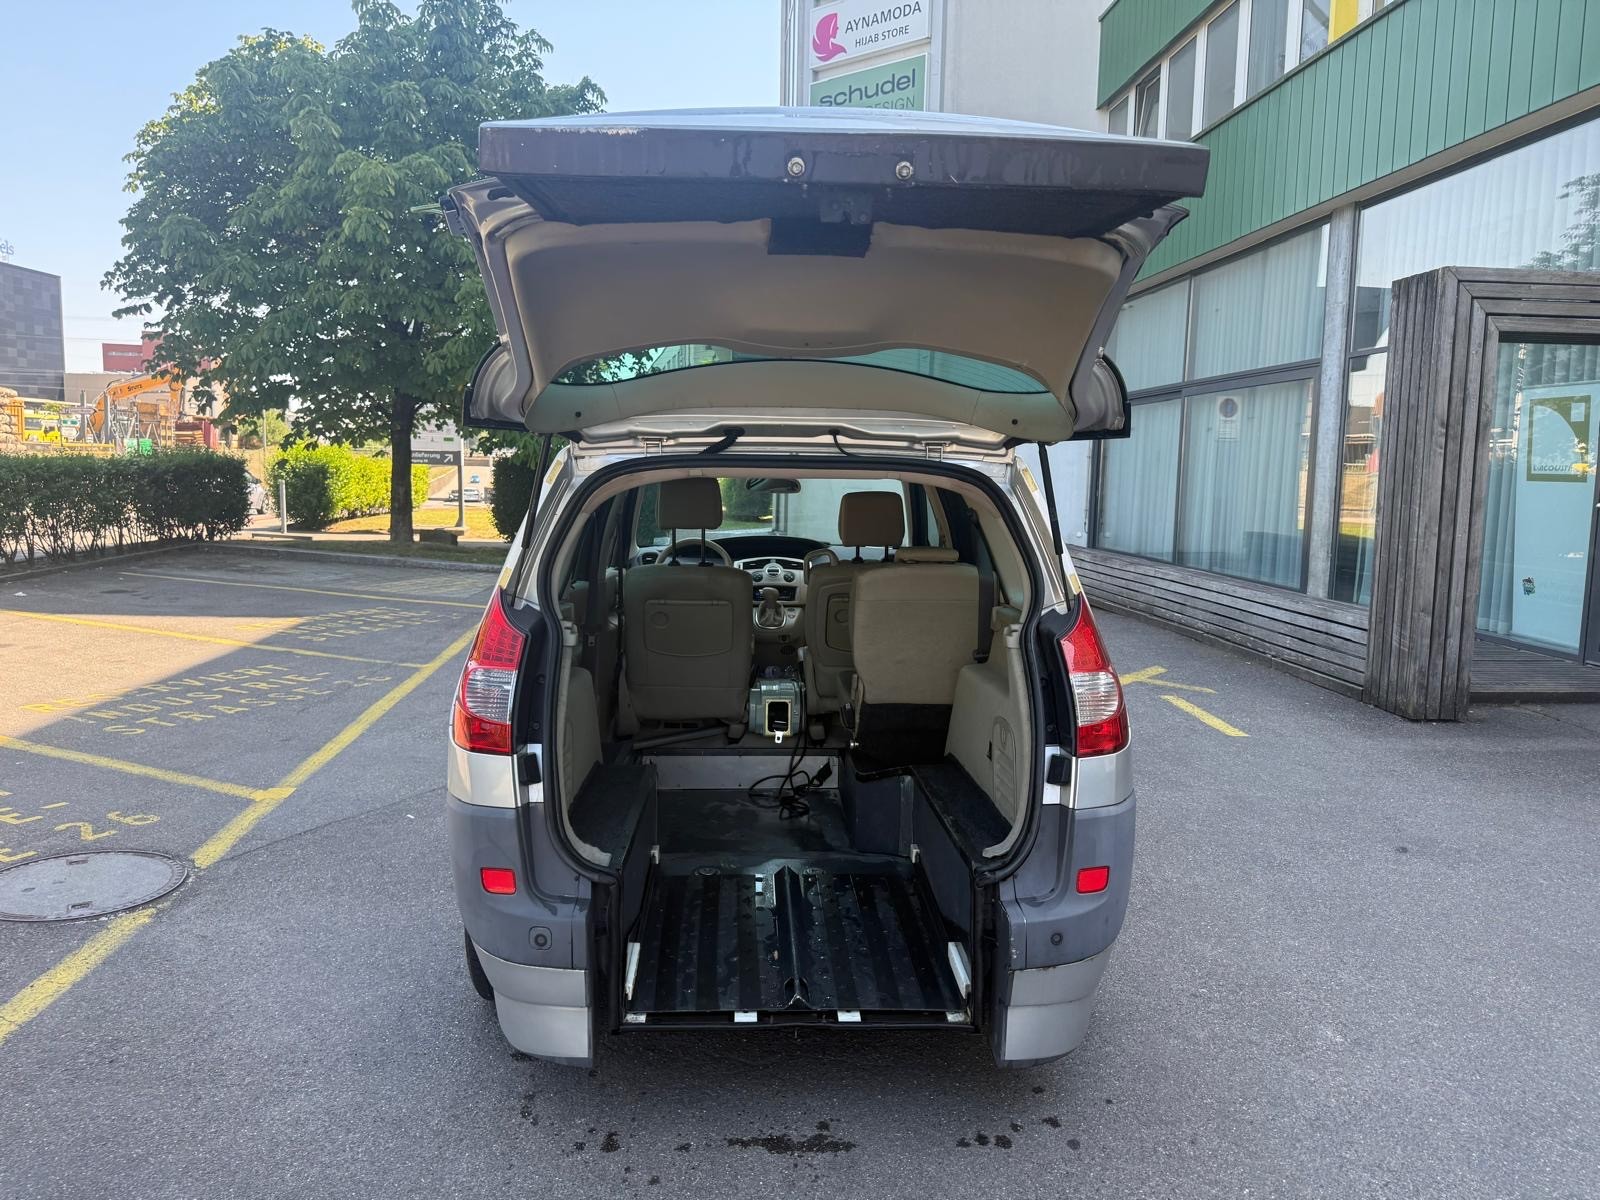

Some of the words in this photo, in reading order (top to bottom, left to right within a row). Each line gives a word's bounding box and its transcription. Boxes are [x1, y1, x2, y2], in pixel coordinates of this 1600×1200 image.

[844, 1, 922, 34] AYNAMODA
[855, 32, 880, 48] HIJAB
[881, 25, 910, 41] STORE
[819, 68, 916, 107] schudel
[19, 664, 290, 713] RESERVIERT
[103, 686, 336, 736] STRASSE
